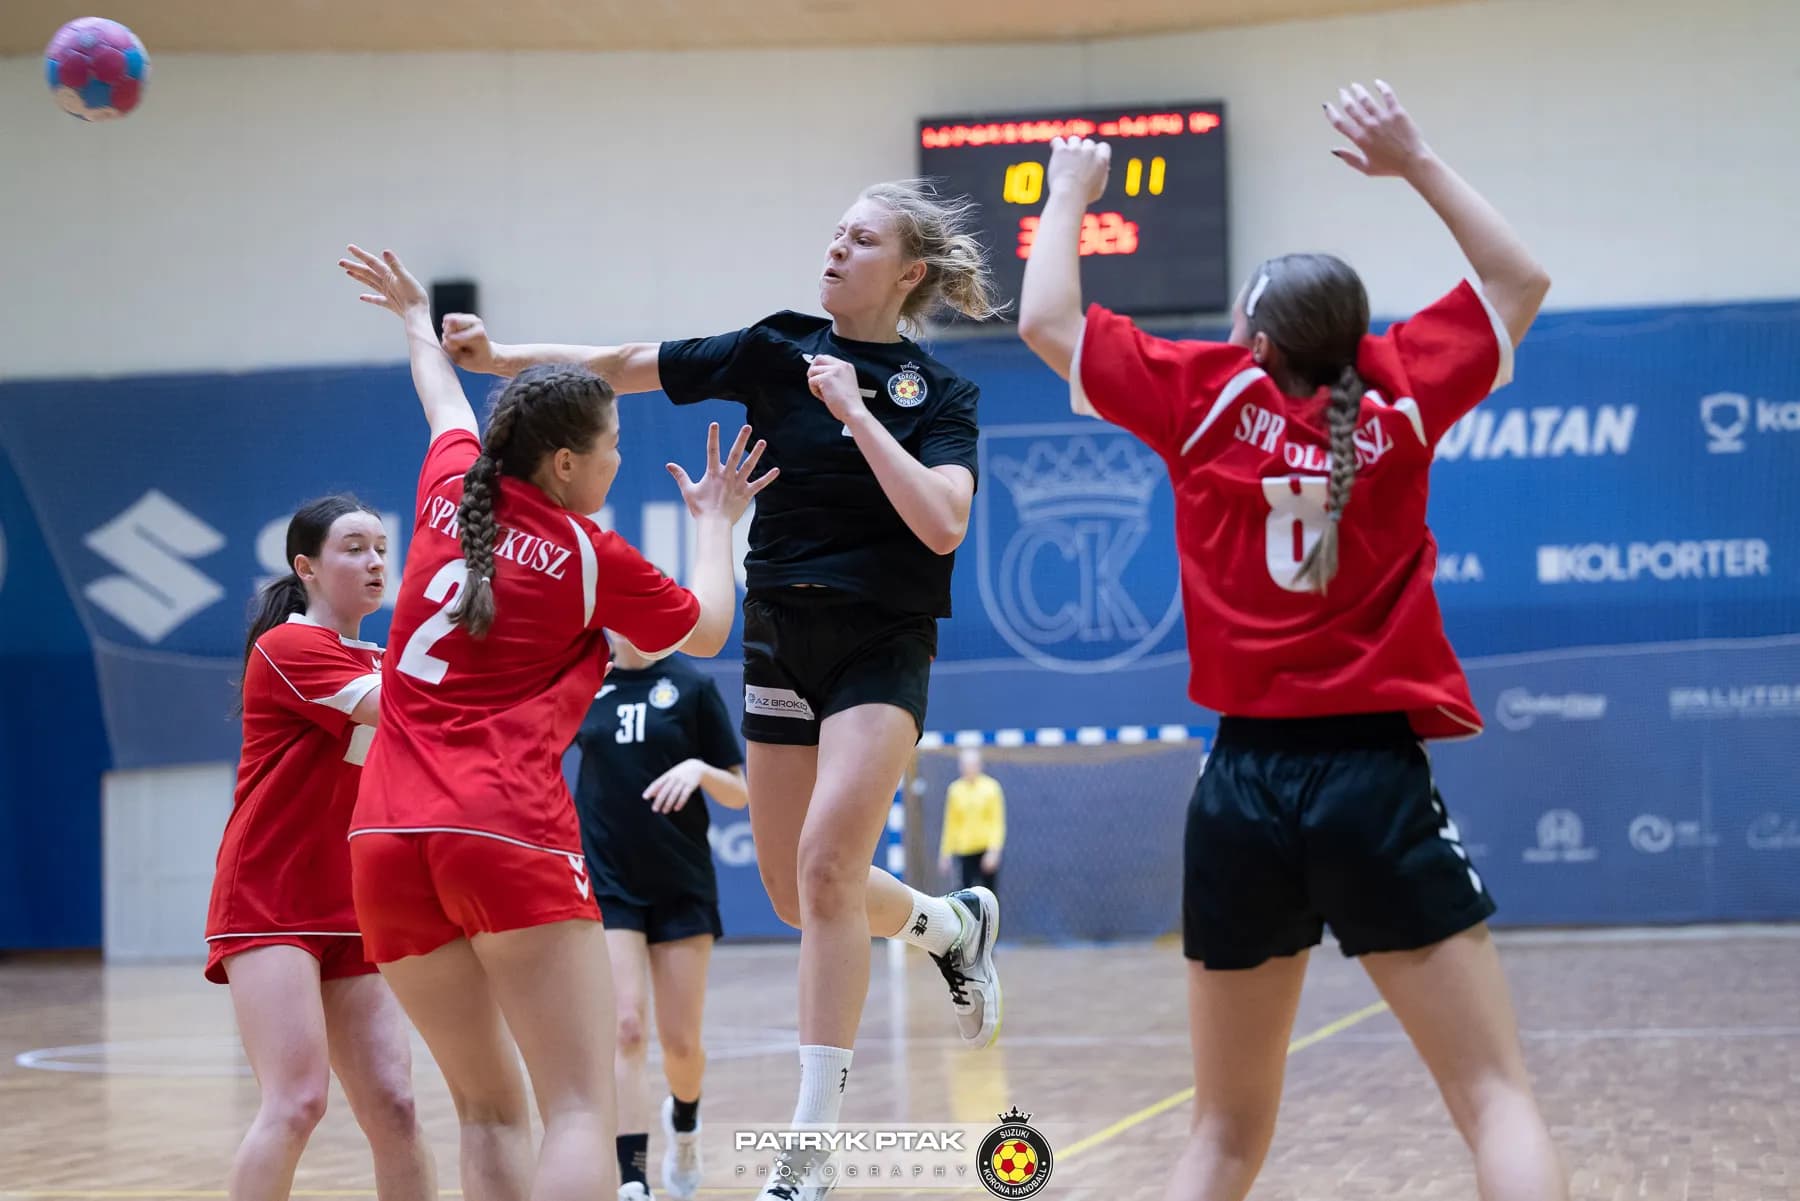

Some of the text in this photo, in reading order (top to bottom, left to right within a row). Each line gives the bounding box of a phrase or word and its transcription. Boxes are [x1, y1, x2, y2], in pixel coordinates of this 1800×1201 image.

[1003, 156, 1166, 204] 10 11
[1234, 402, 1395, 474] SPR OLSZ
[492, 524, 573, 581] KUSZ
[1261, 474, 1339, 593] 8
[1560, 539, 1770, 582] KOLPORTER
[396, 557, 470, 686] 2
[615, 702, 647, 744] 31
